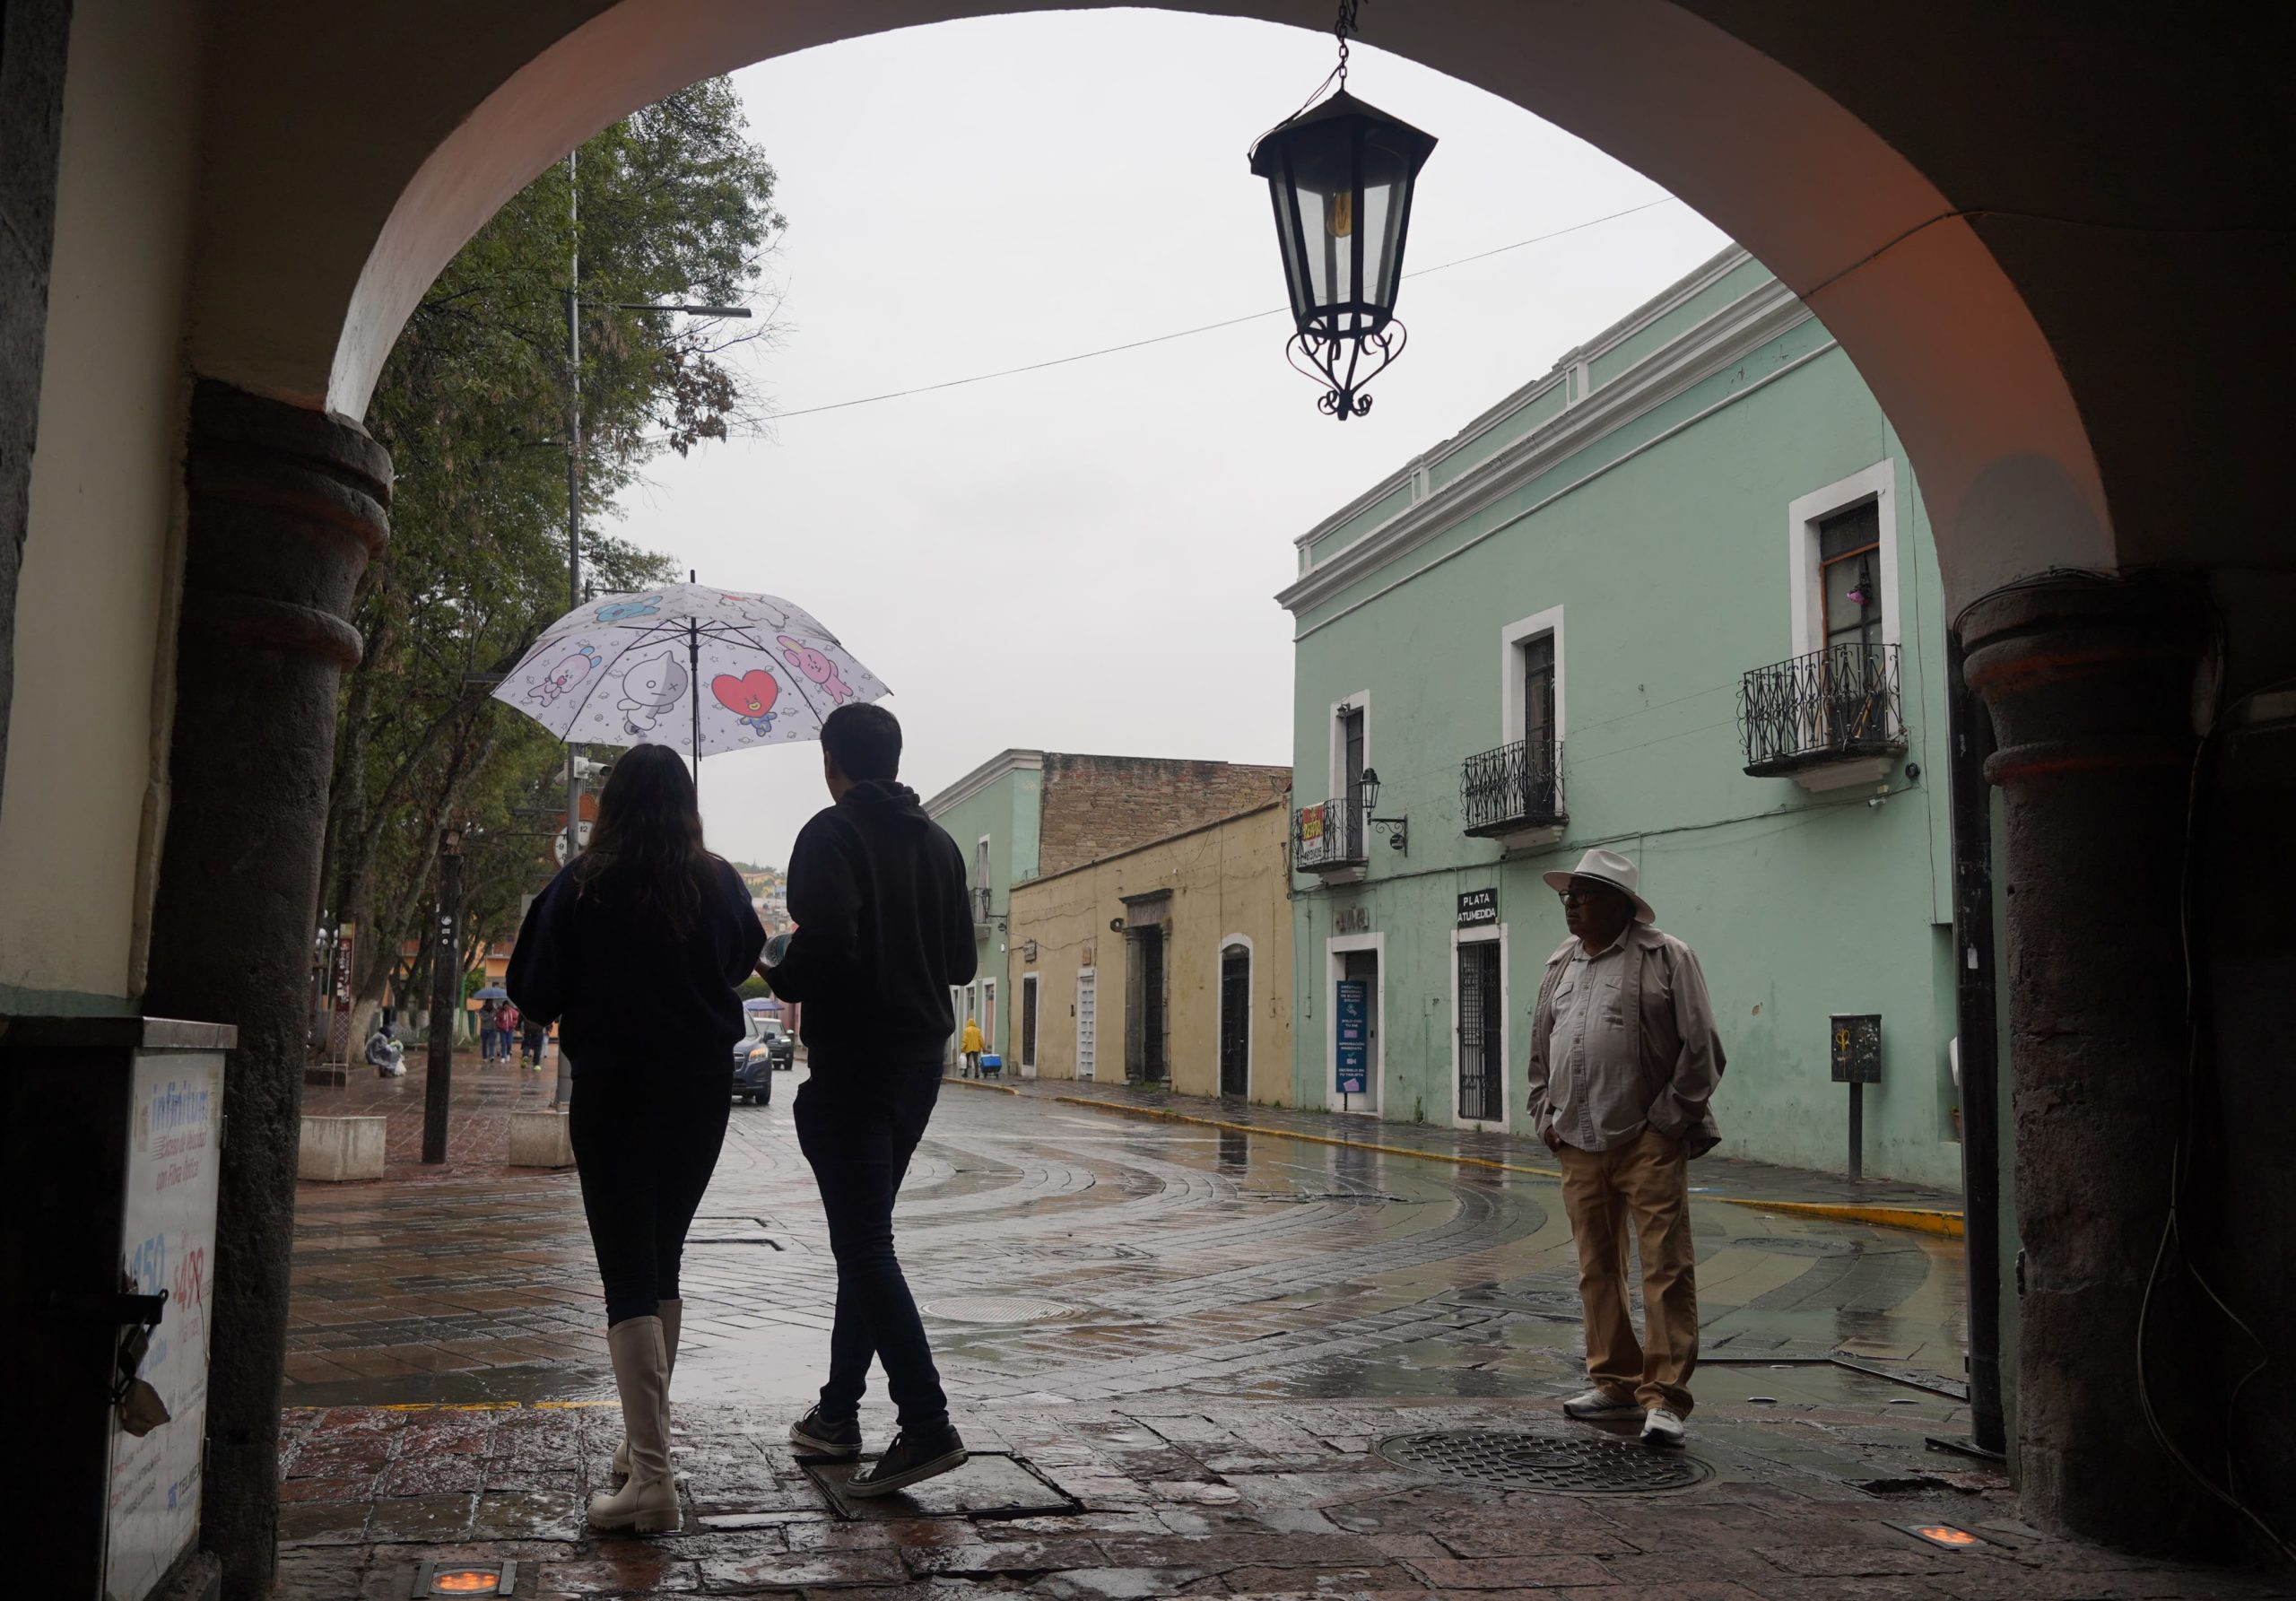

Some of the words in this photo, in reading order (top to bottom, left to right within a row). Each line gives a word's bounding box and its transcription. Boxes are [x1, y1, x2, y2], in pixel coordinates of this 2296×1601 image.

[1463, 892, 1491, 907] PLATA
[152, 1080, 208, 1131] infinitum
[173, 1247, 204, 1312] $499
